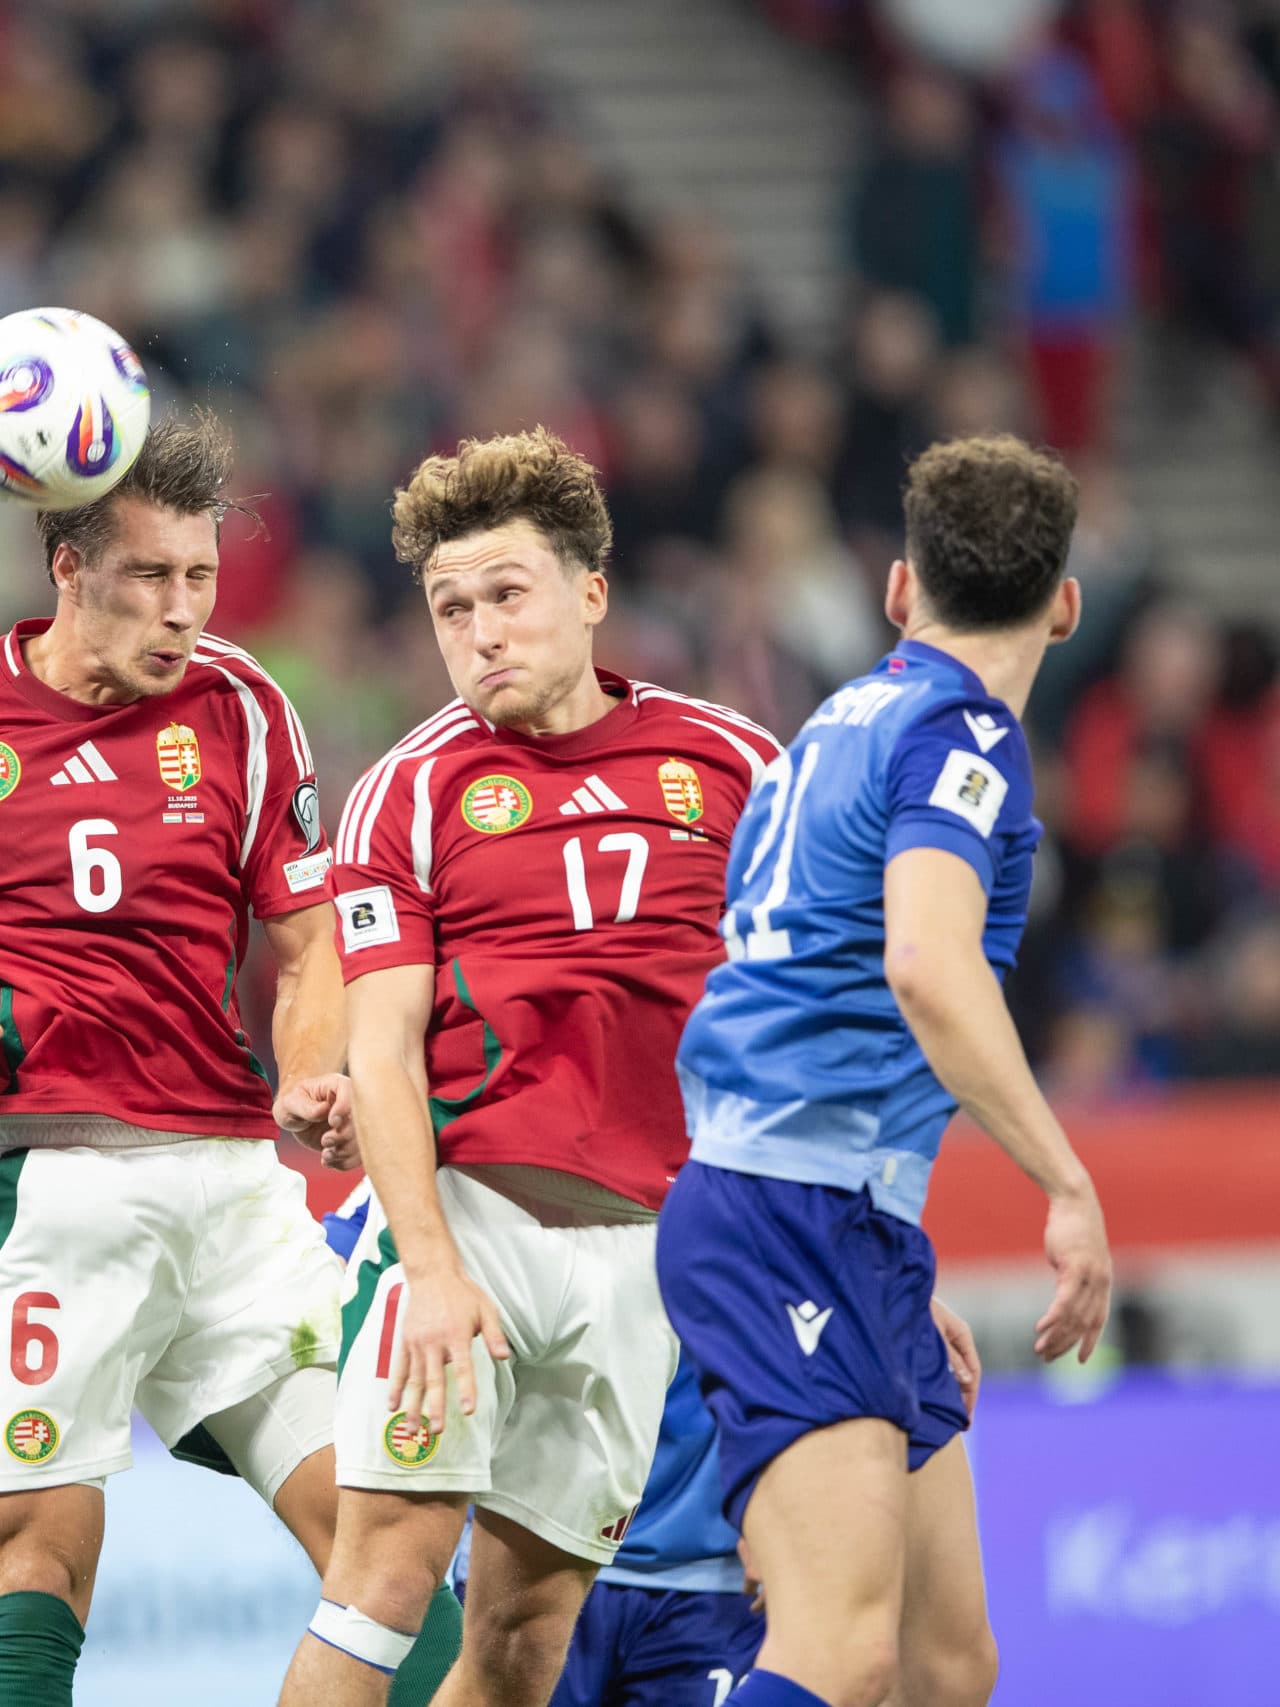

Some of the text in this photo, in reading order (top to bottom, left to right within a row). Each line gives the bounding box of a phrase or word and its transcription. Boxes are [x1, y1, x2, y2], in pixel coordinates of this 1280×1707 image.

[68, 818, 122, 913] 6
[562, 832, 650, 931] 17
[9, 1291, 61, 1386] 6
